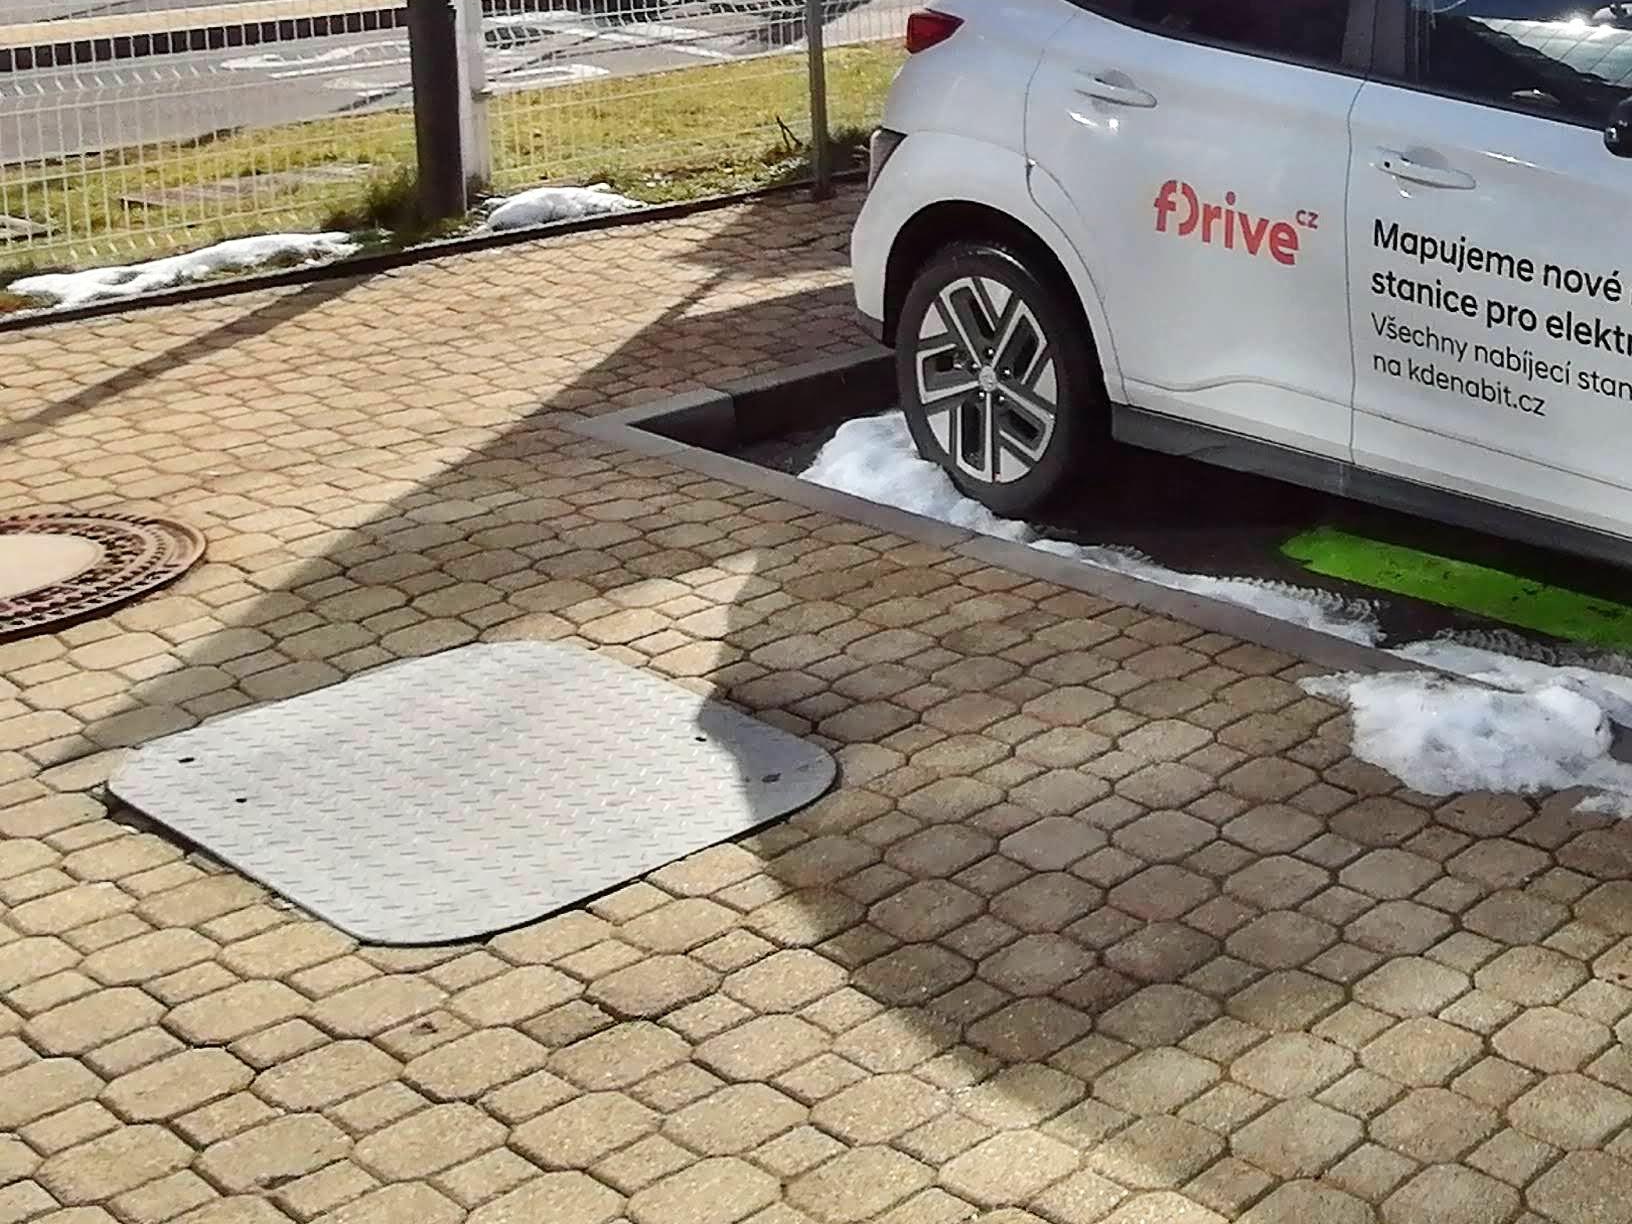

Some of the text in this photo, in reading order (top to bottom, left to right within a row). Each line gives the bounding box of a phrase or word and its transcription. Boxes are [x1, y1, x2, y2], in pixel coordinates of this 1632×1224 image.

[1373, 218, 1535, 283] Mapujeme
[1542, 263, 1622, 303] nové
[1371, 270, 1479, 318] stanice
[1486, 299, 1538, 332] pro
[1371, 311, 1469, 363] Všechny
[1474, 344, 1572, 386] nabíjecí
[1373, 354, 1546, 417] na kdenabit.cz
